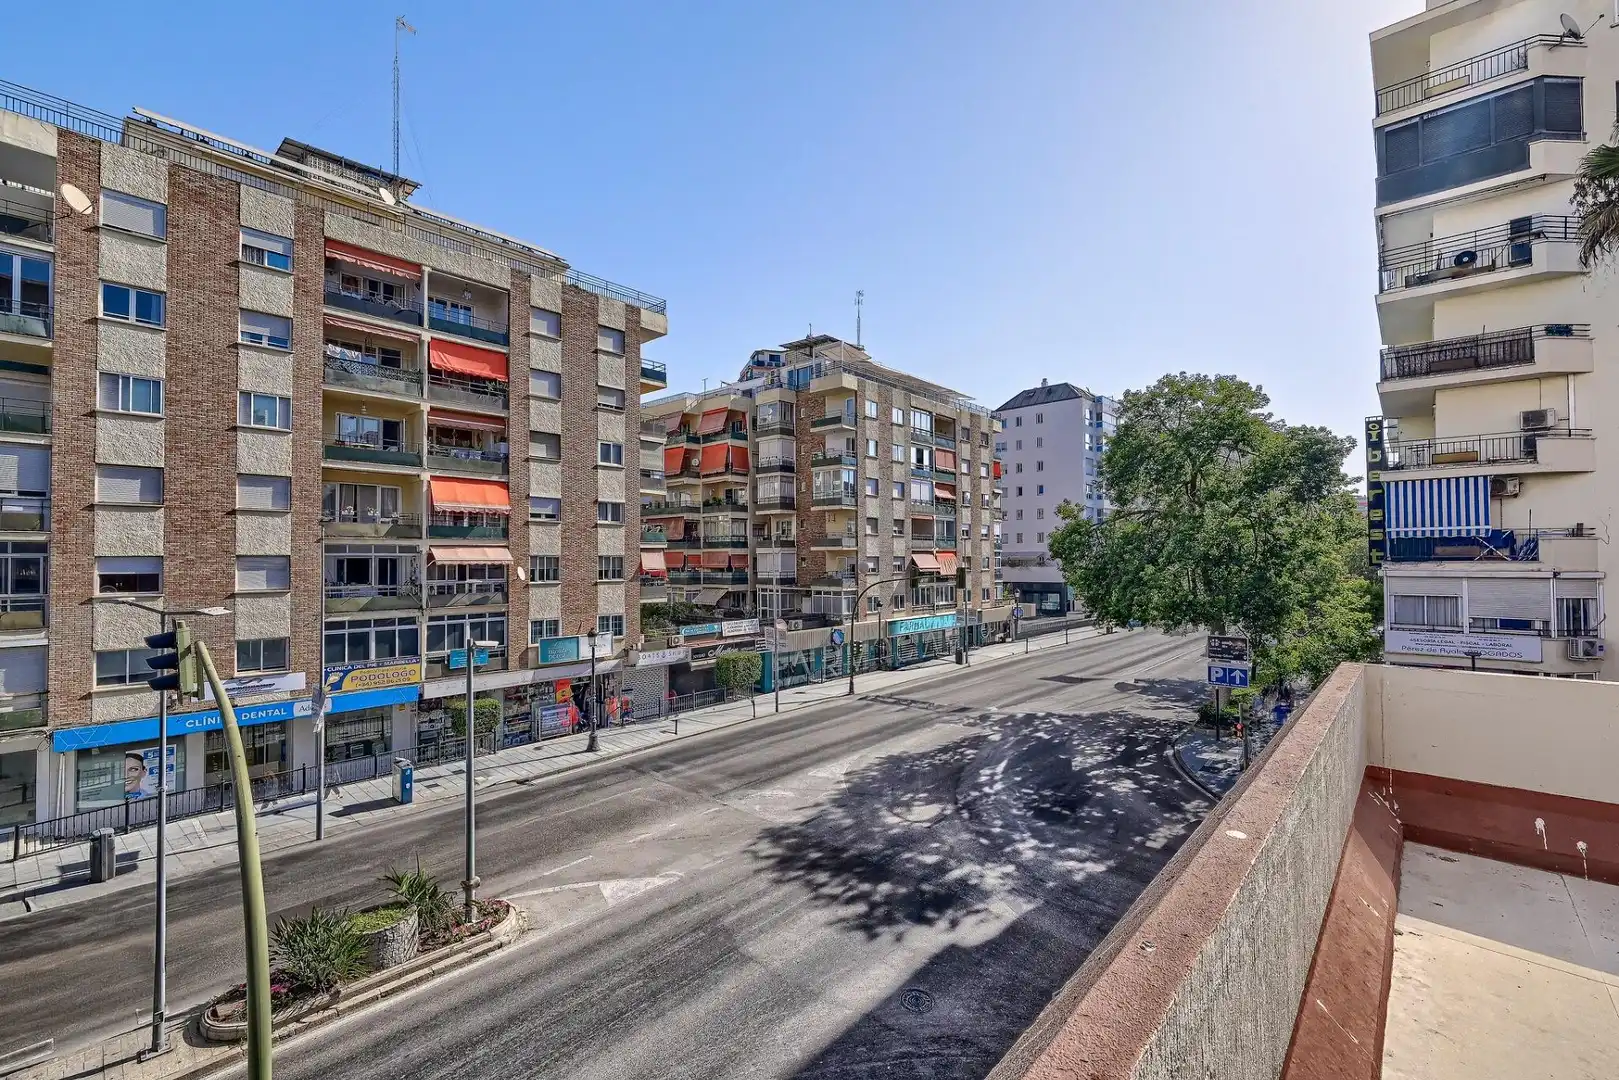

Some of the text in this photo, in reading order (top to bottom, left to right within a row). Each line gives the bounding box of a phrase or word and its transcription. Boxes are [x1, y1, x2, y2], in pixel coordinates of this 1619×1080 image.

[1210, 666, 1224, 682] P
[186, 715, 221, 728] CLÍNI
[242, 708, 287, 720] DENTAL
